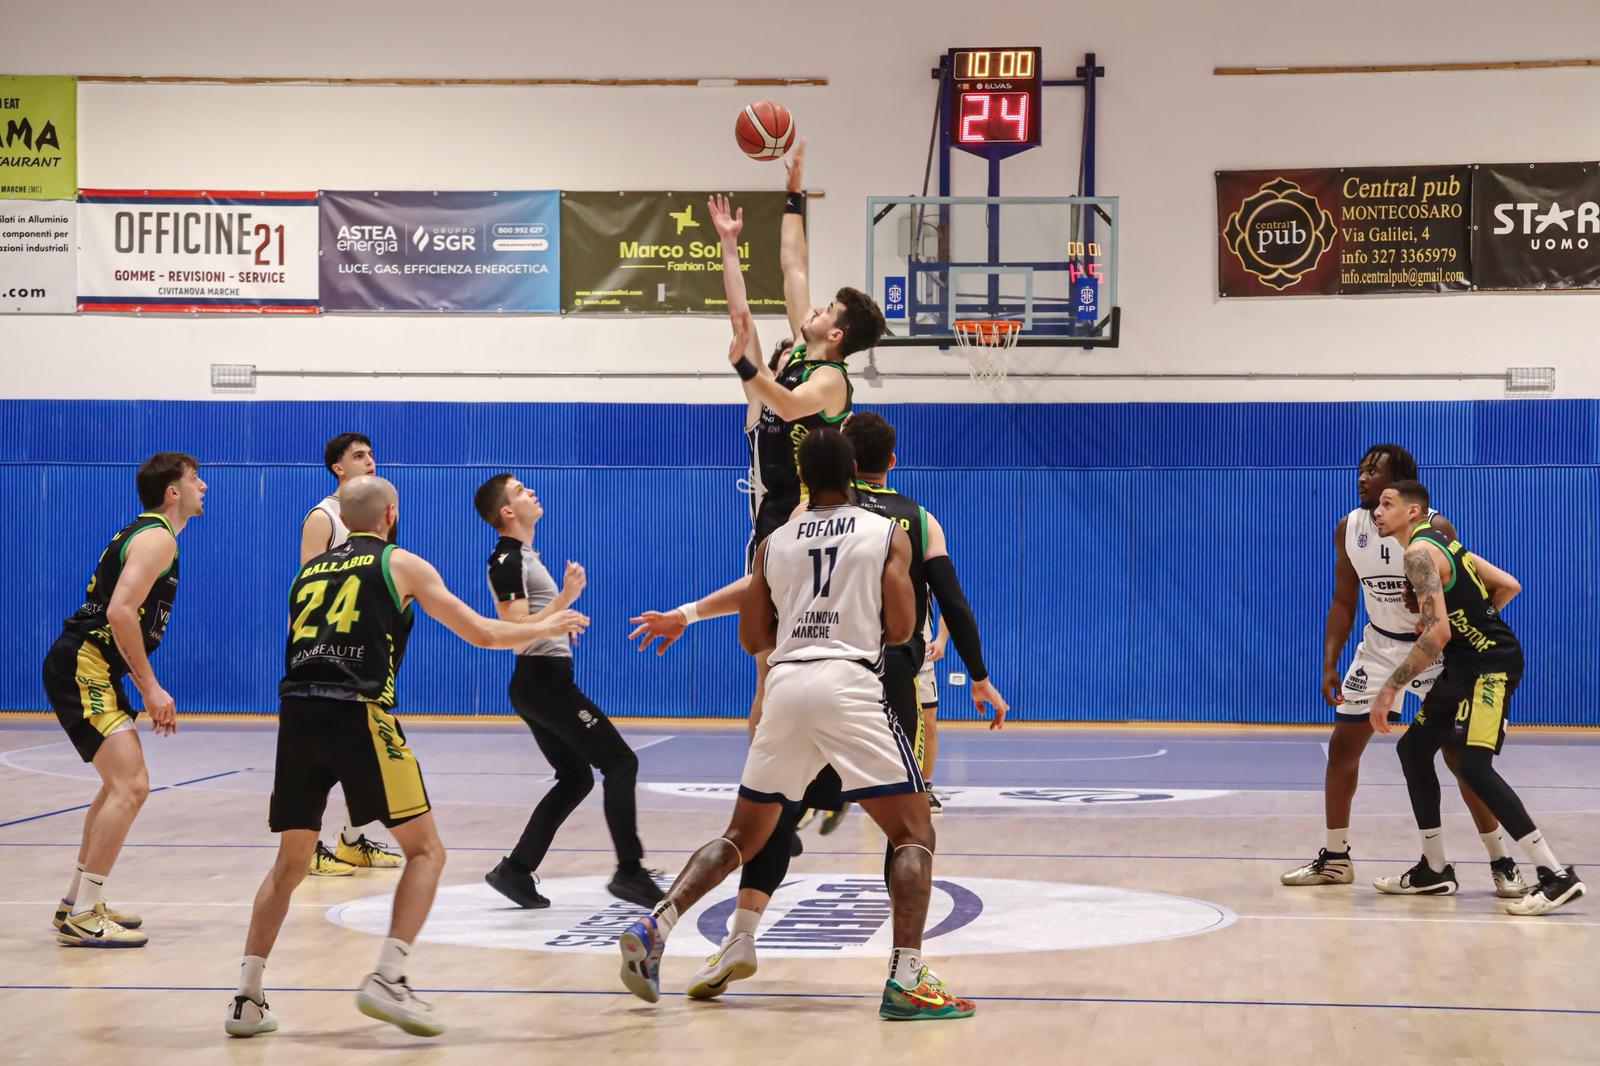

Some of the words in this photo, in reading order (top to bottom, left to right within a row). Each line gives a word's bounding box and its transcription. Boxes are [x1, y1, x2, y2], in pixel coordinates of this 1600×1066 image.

[984, 82, 1013, 90] ELVAS
[4, 98, 20, 110] EAT
[962, 95, 1027, 141] 24
[1, 186, 27, 194] MARCHE
[28, 185, 42, 194] (MC)
[1342, 176, 1418, 200] Central
[1421, 174, 1462, 203] pub
[18, 215, 26, 224] in
[28, 214, 69, 224] Alluminio
[1341, 203, 1463, 221] MONTECOSARO
[337, 225, 397, 240] ASTEA
[433, 227, 476, 235] GRUPPO
[497, 226, 513, 235] 800
[1255, 221, 1291, 230] central
[2, 229, 52, 240] componenti
[54, 231, 69, 240] per
[114, 211, 251, 255] OFFICINE
[254, 223, 286, 266] 21
[1257, 220, 1307, 253] pub
[1342, 228, 1366, 243] Via
[1368, 226, 1418, 244] Galilei,
[1421, 226, 1430, 241] 4
[26, 243, 69, 253] industriali
[336, 239, 398, 255] energia
[432, 235, 476, 251] SGR
[619, 241, 684, 259] Marco
[689, 240, 750, 259] Solni
[1530, 238, 1589, 251] UOMO
[1341, 249, 1368, 265] info
[1373, 249, 1396, 264] 327
[1400, 247, 1458, 263] 3365979
[338, 263, 372, 275] LUCE,
[374, 264, 402, 276] GAS,
[404, 264, 472, 275] EFFICIENZA
[475, 264, 549, 275] ENERGETICA
[667, 261, 705, 272] Fashion
[707, 261, 750, 272] Deser
[114, 270, 156, 282] GOMME
[168, 270, 226, 283] REVISIONI
[238, 271, 286, 284] SERVICE
[1341, 267, 1466, 288] info.centralpub@gmail.com
[158, 286, 206, 296] CIVITANOVA
[207, 288, 240, 297] MARCHE
[886, 303, 904, 312] FIP
[1078, 305, 1096, 313] FIP
[796, 516, 857, 541] FOFANA
[1380, 543, 1391, 565] 4
[300, 554, 375, 580] BALLABIO
[292, 574, 362, 645] 24
[791, 625, 831, 640] MARCHE
